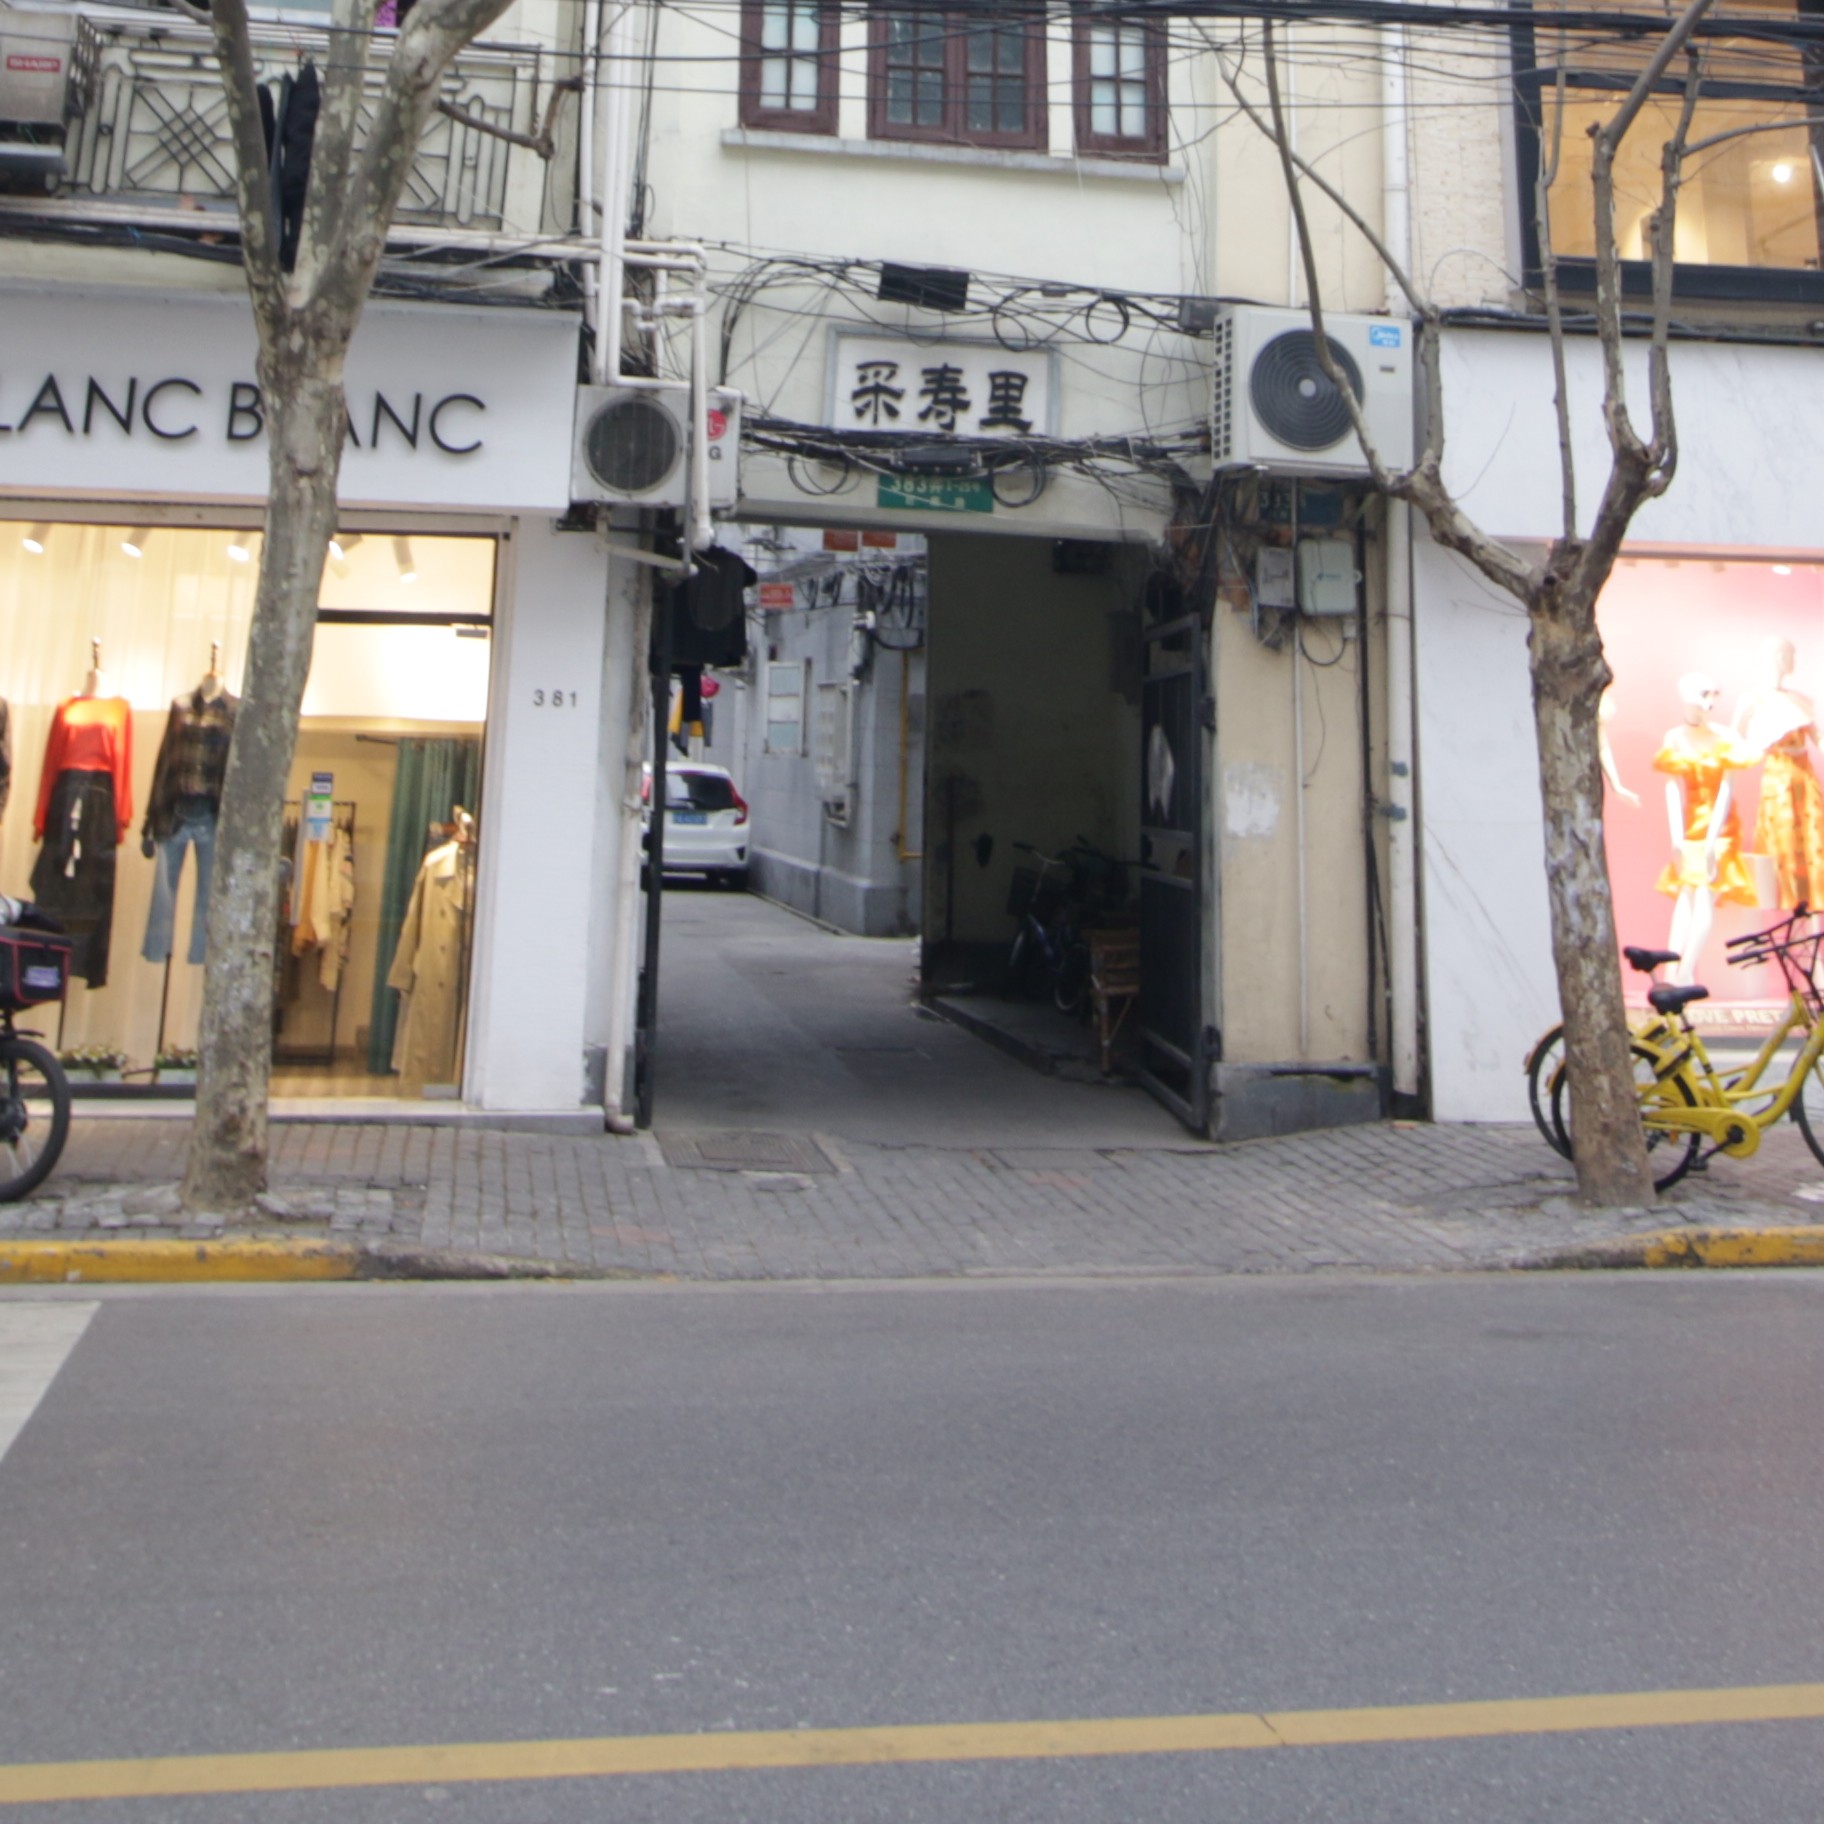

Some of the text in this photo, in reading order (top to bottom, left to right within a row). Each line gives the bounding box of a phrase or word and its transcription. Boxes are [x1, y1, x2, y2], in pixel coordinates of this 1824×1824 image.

[227, 382, 486, 454] BNC
[852, 361, 1033, 433] 采寿里
[533, 688, 577, 708] 381
